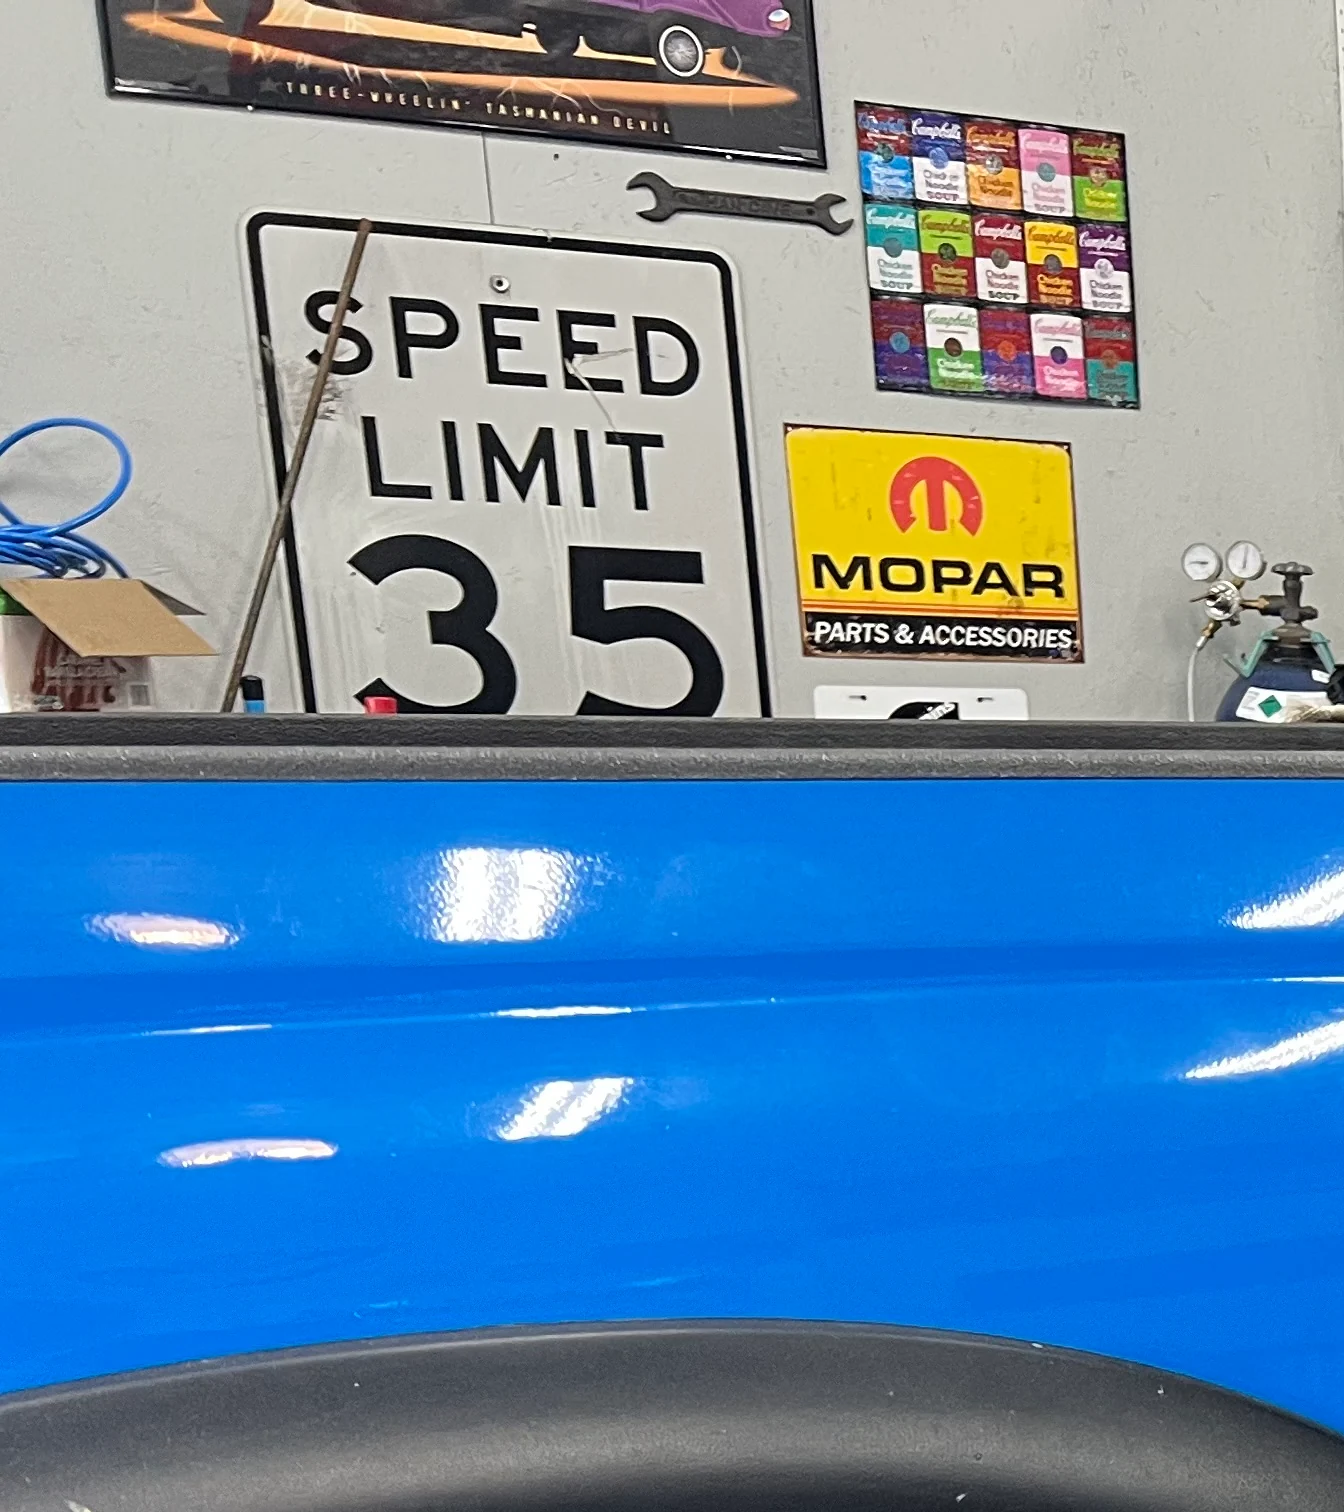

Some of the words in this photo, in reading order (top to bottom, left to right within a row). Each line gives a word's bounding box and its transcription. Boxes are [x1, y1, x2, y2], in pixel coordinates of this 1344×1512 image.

[486, 101, 600, 126] TASMANIAN
[613, 116, 672, 135] DEVIL
[303, 289, 701, 397] SPEED
[360, 415, 665, 512] LIMIT
[810, 553, 1066, 599] MOPAR
[346, 533, 725, 717] 35
[813, 620, 890, 645] PARTS
[894, 622, 914, 645] &
[919, 624, 1073, 650] ACCESSORIES
